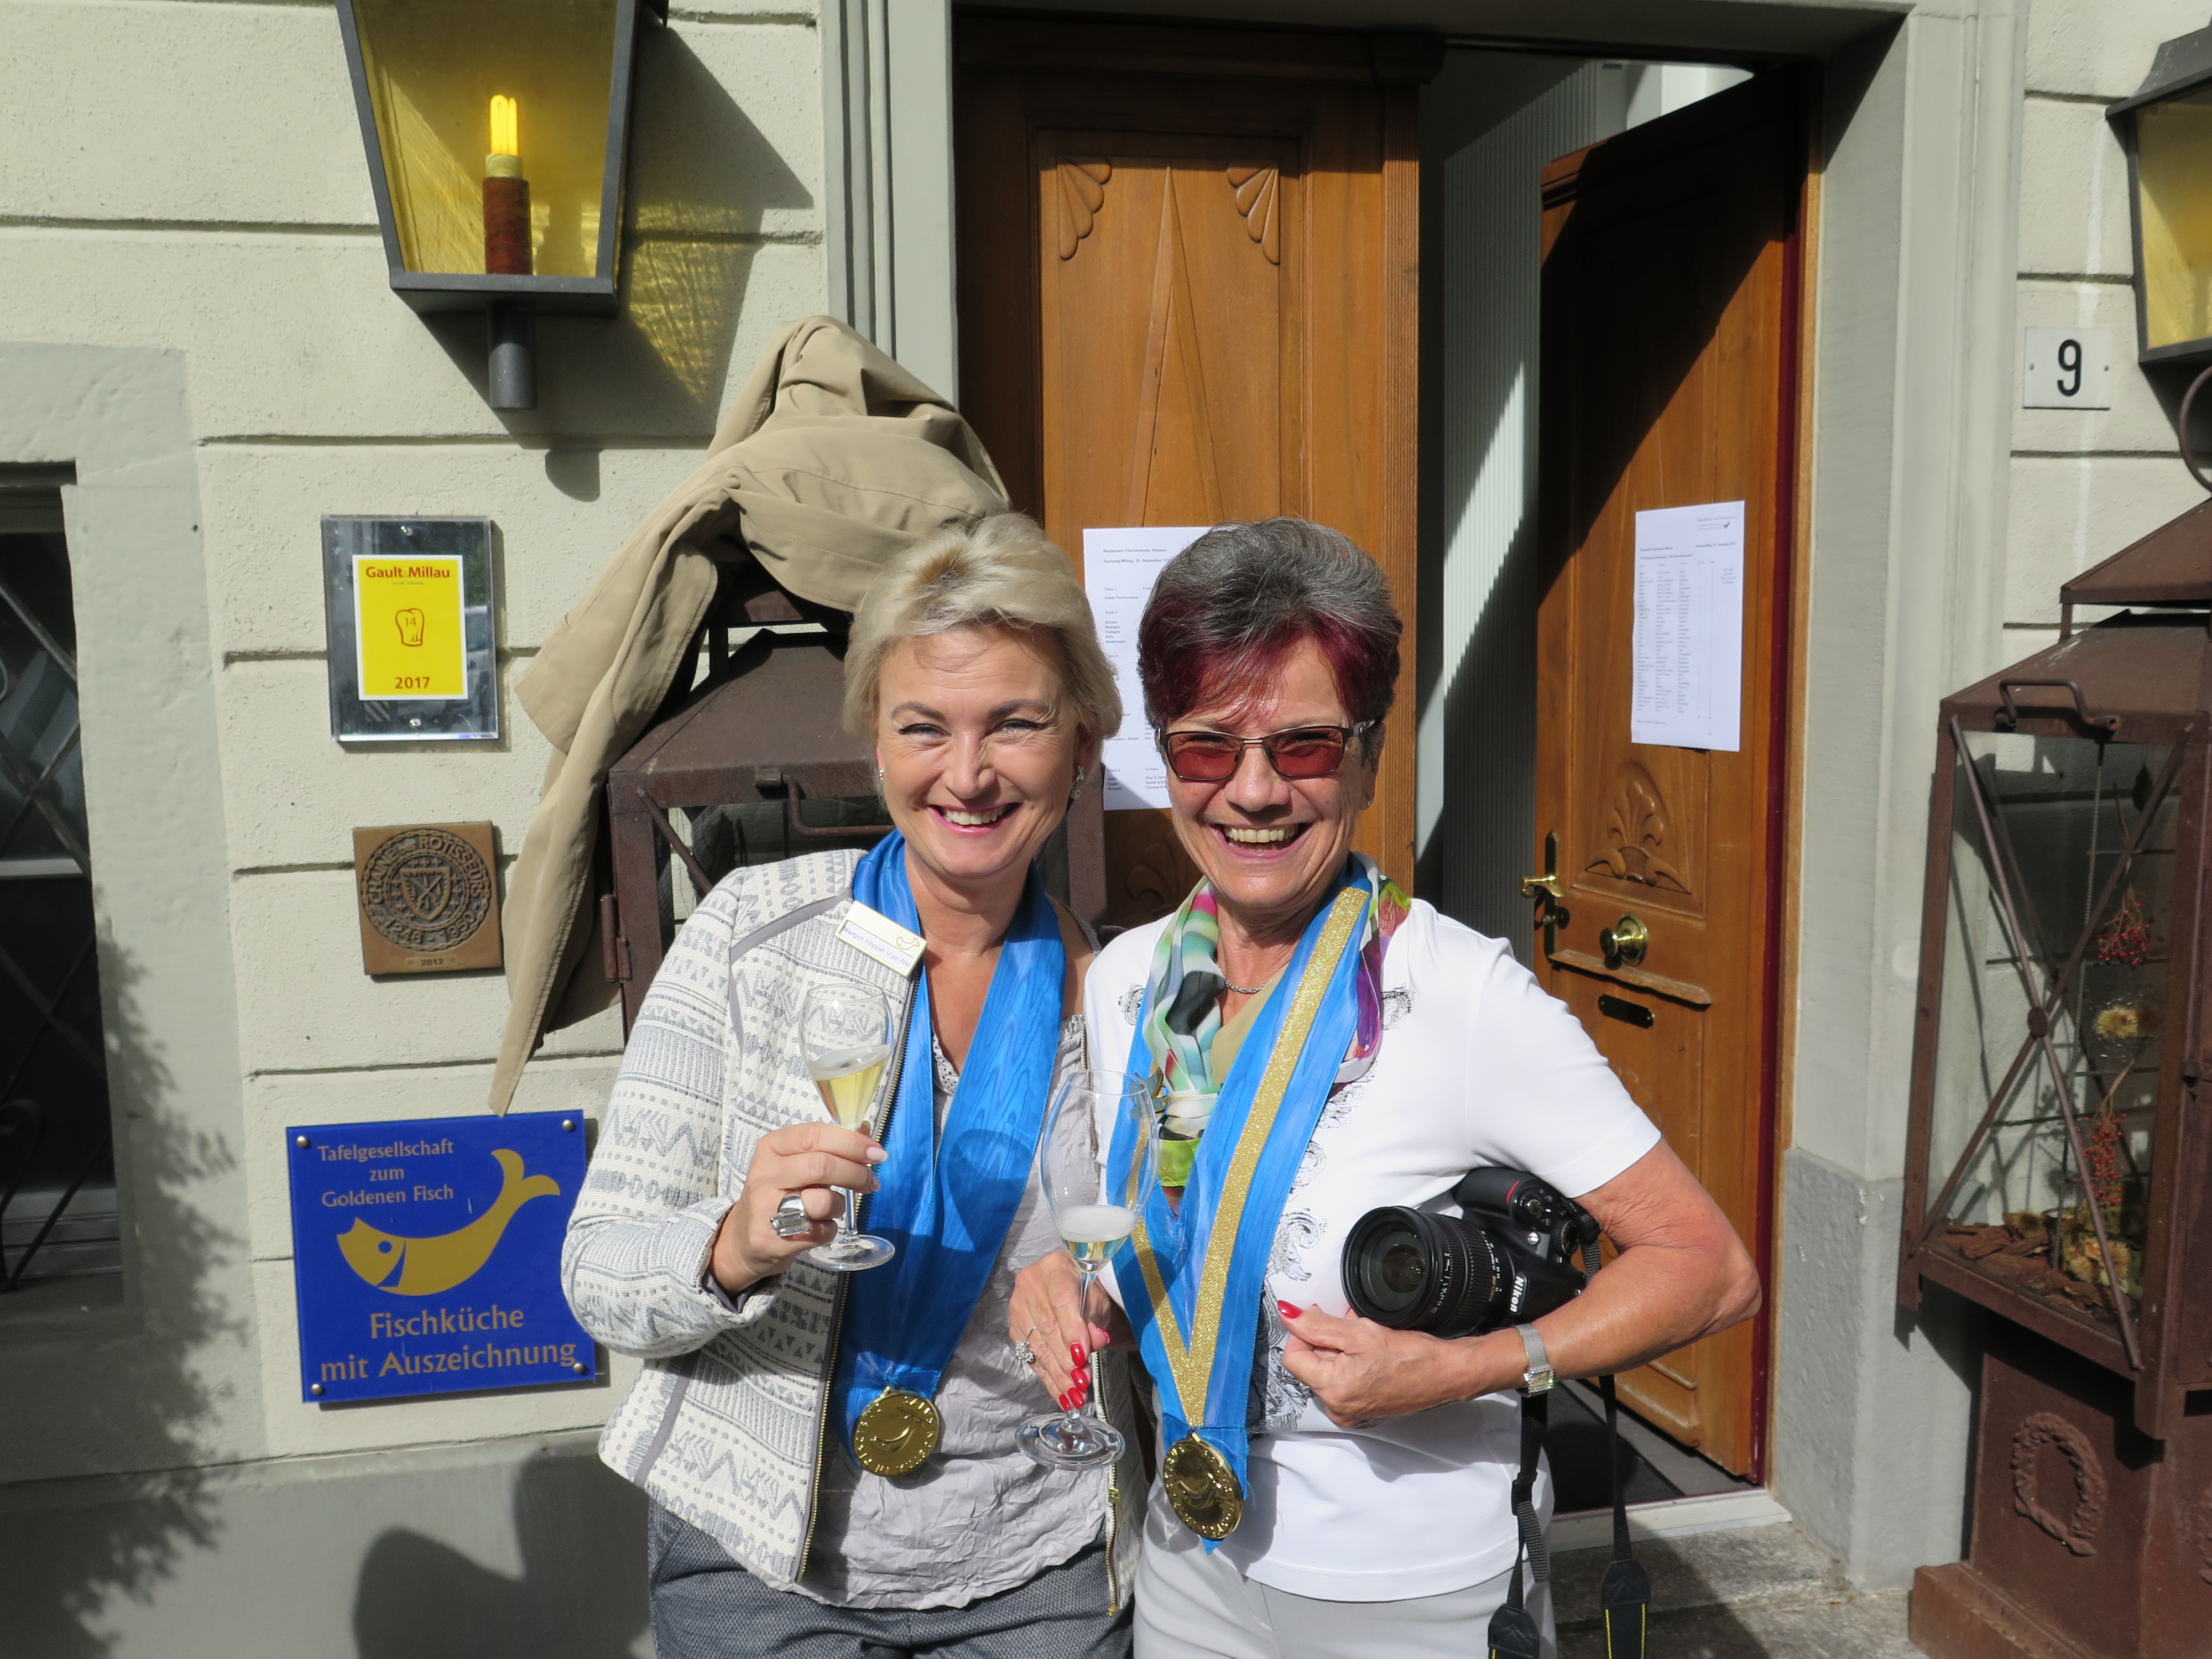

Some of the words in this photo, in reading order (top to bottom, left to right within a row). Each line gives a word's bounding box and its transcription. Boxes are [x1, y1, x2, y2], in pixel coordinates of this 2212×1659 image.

[2057, 338, 2081, 397] 9
[404, 617, 416, 627] 14
[395, 677, 430, 689] 2017
[368, 849, 398, 904] CHAINE
[419, 836, 483, 899] ROTISSEURS
[384, 918, 423, 944] 1248
[440, 912, 476, 942] 1950
[843, 926, 864, 942] Margot
[317, 1139, 454, 1162] Tafelgesellschaft
[369, 1168, 404, 1181] zum
[322, 1190, 406, 1207] Goldenen
[414, 1185, 453, 1201] Fisch
[1510, 1276, 1525, 1312] Nikon
[370, 1306, 524, 1339] Fischküche
[321, 1354, 368, 1382] mit
[378, 1343, 576, 1377] Auszeichnung
